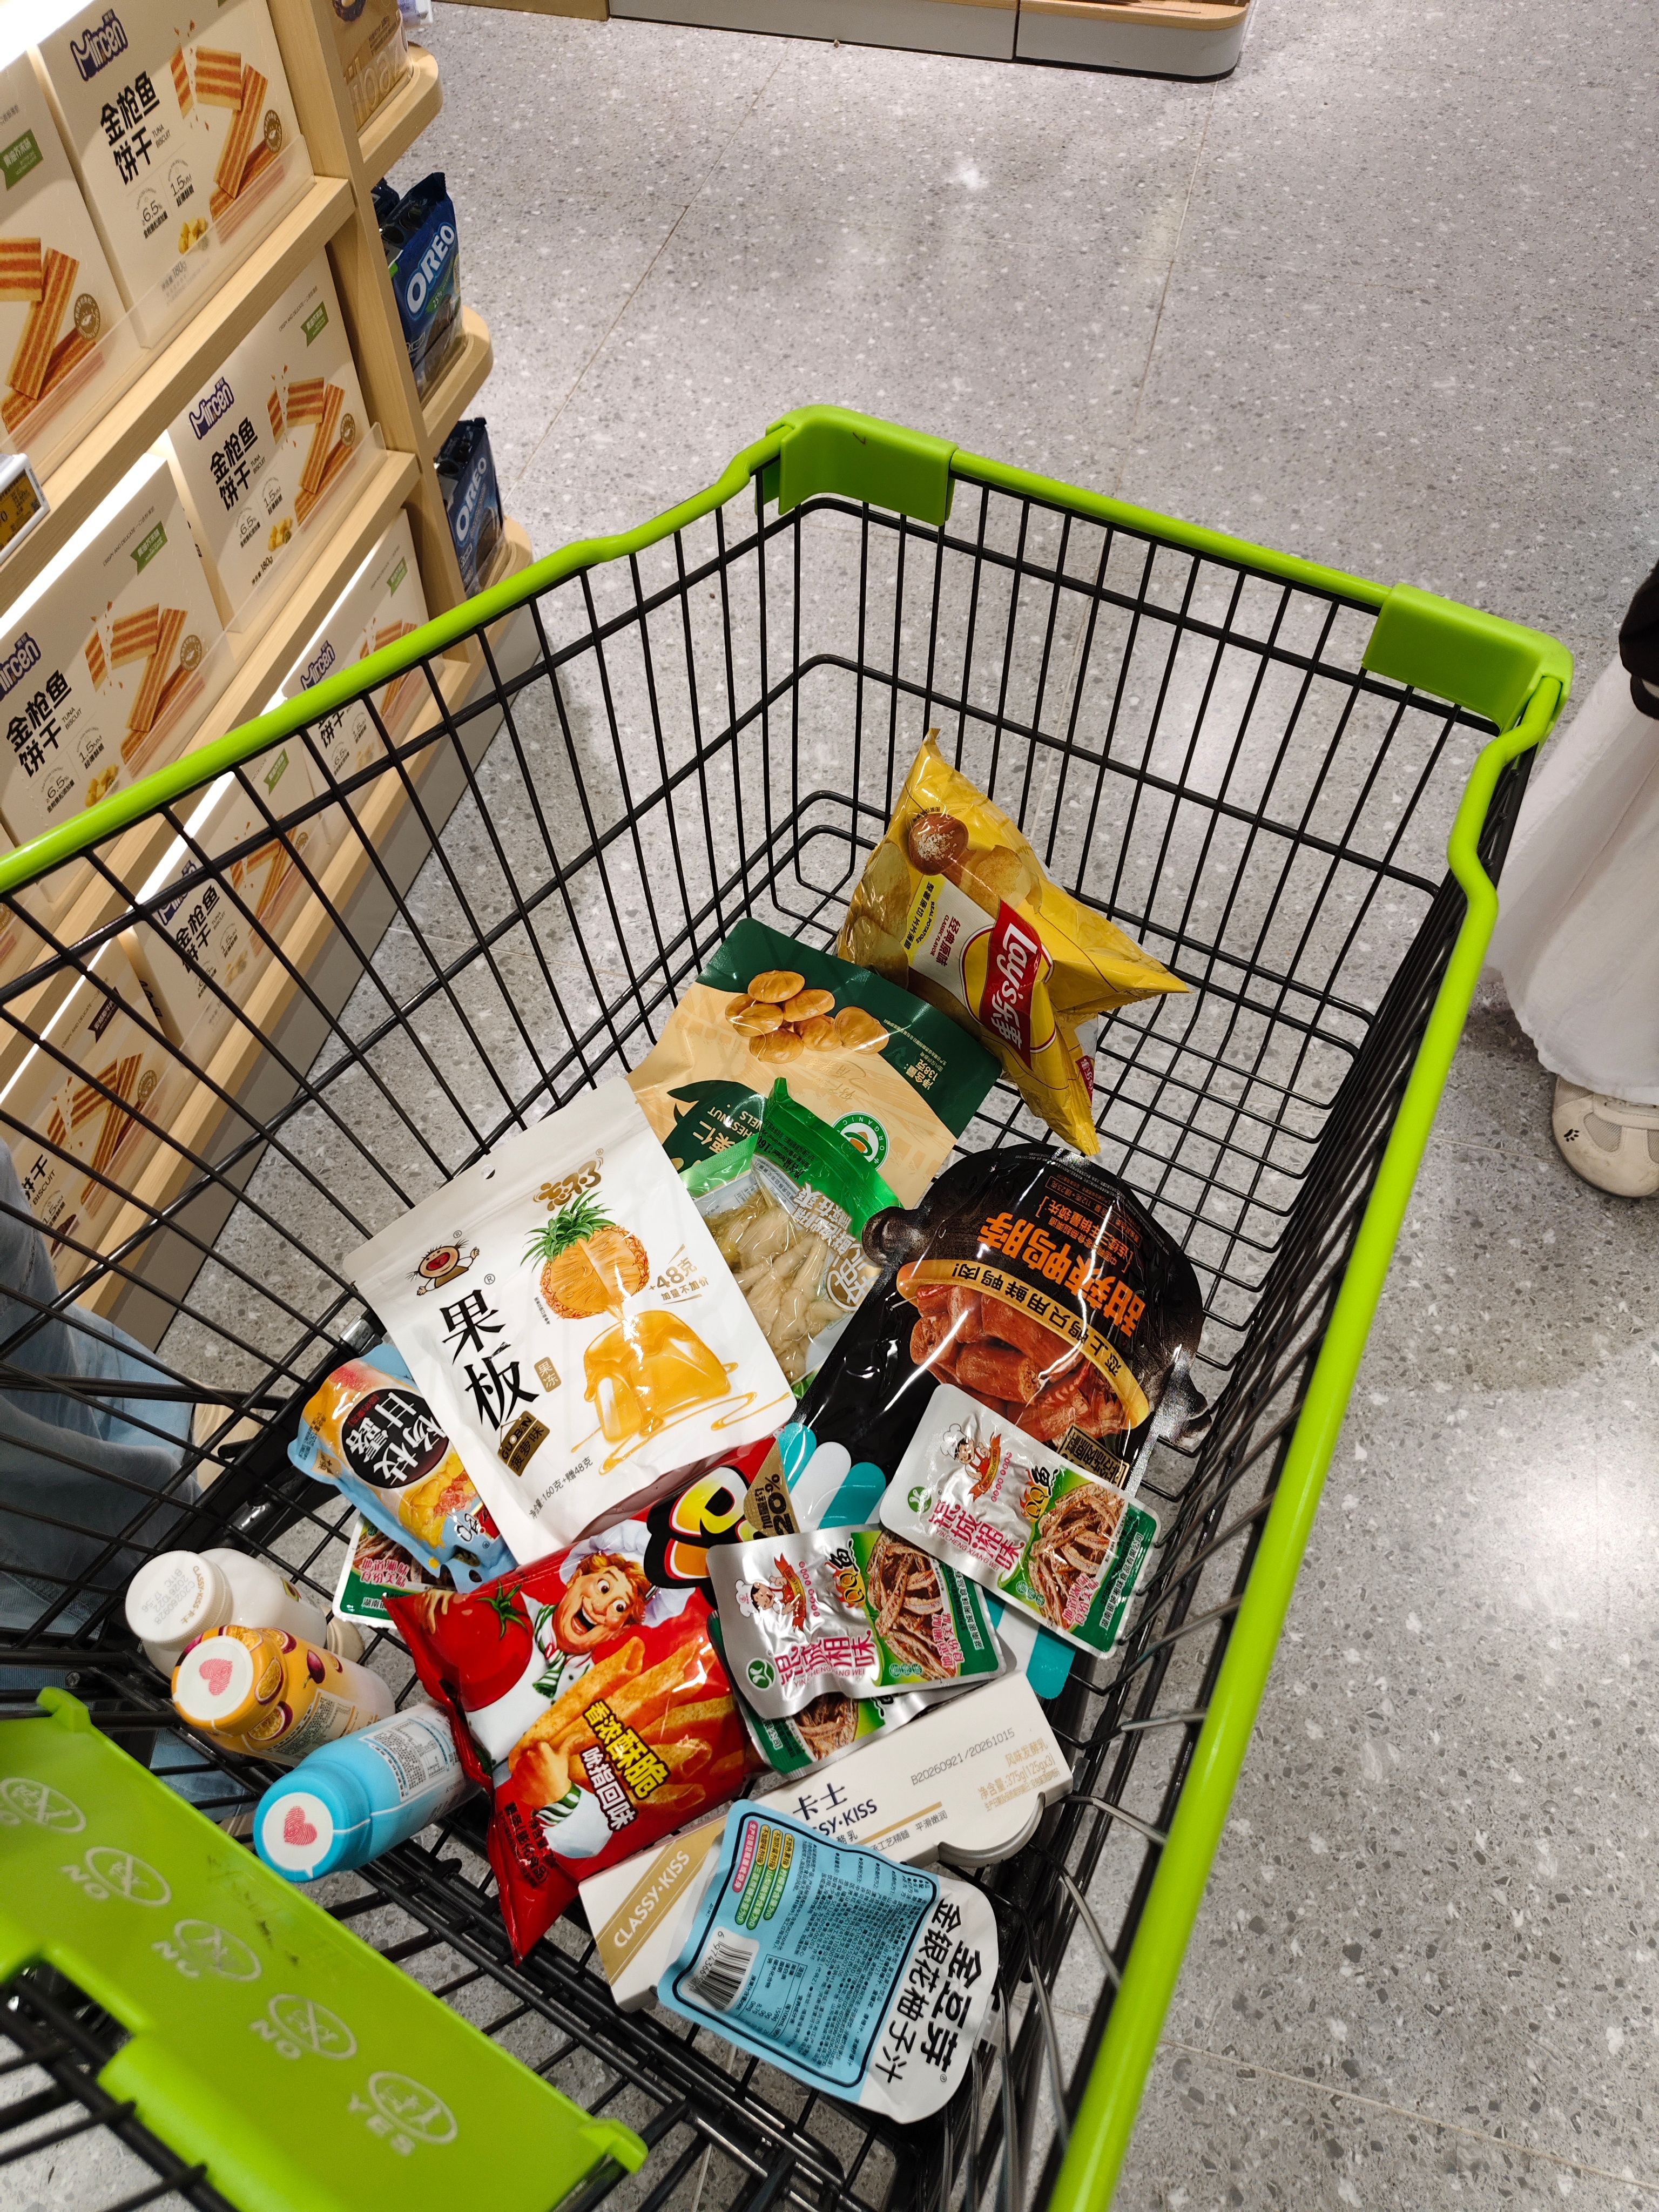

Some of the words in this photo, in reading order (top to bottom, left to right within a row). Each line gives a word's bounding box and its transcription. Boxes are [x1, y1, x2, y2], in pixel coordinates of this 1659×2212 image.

[100, 71, 160, 146] 金枪鱼
[152, 124, 164, 138] TUNA
[113, 126, 152, 185] 饼干
[156, 130, 171, 148] BISCUIT
[407, 225, 455, 314] OREO
[189, 382, 234, 440] Mircen
[210, 417, 258, 485] 金枪鱼
[251, 454, 260, 467] TUNA
[253, 456, 267, 474] BISCUIT
[219, 460, 251, 511] 饼干
[456, 457, 486, 541] OREO
[6, 670, 72, 753] 金枪鱼
[62, 707, 76, 723] TUNA
[65, 707, 82, 730] BISCUIT
[19, 718, 62, 778] 饼干
[79, 735, 103, 763] 1.5MM
[176, 885, 220, 949] 金枪鱼
[916, 914, 932, 945] POTATOES
[936, 914, 949, 940] CLASSIC
[930, 938, 940, 957] FLAVOR
[935, 916, 962, 967] 经典原味
[996, 923, 1038, 1002] Lay's
[903, 1063, 935, 1091] 净含量:
[916, 1058, 943, 1081] 138克
[707, 1106, 756, 1138] HESNUT
[32, 1169, 55, 1205] BISCUIT
[1049, 1200, 1130, 1259] 连续三年销量领先
[649, 1257, 697, 1291] +48克
[660, 1274, 709, 1301] 加量不加价
[976, 1211, 1147, 1337] 甜辣鸭脖
[538, 1361, 559, 1388] 果冻
[346, 1392, 417, 1463] 甘露
[373, 1414, 447, 1486] 杨枝
[501, 1415, 533, 1460] GUOBAN
[510, 1426, 545, 1472] 菠萝味
[765, 1474, 792, 1537] 20%
[361, 1555, 409, 1577] 地道湘味
[936, 1528, 947, 1539] YIN
[946, 1533, 968, 1551] CHENG
[967, 1546, 989, 1564] XIANG
[988, 1559, 1000, 1572] WEI
[153, 1574, 190, 1615] 20261022
[1099, 1532, 1144, 1629] 湖南银城湘味食品有限公司
[583, 1700, 673, 1801] 香浓酥脆
[911, 1727, 1015, 1786] B20260921/20261015
[1005, 1737, 1048, 1768] 风味发酵乳
[580, 1746, 640, 1831] 吮指回味
[793, 1782, 848, 1820] 卡士
[915, 1811, 948, 1832] 平滑嫩润
[61, 1862, 110, 1901] NO
[613, 1850, 690, 1948] CLASSY·KISS
[875, 1896, 962, 2083] 金银花柚子汁
[921, 1940, 982, 2073] 金豆芽
[251, 2018, 303, 2060] NO
[348, 2091, 416, 2157] YES
